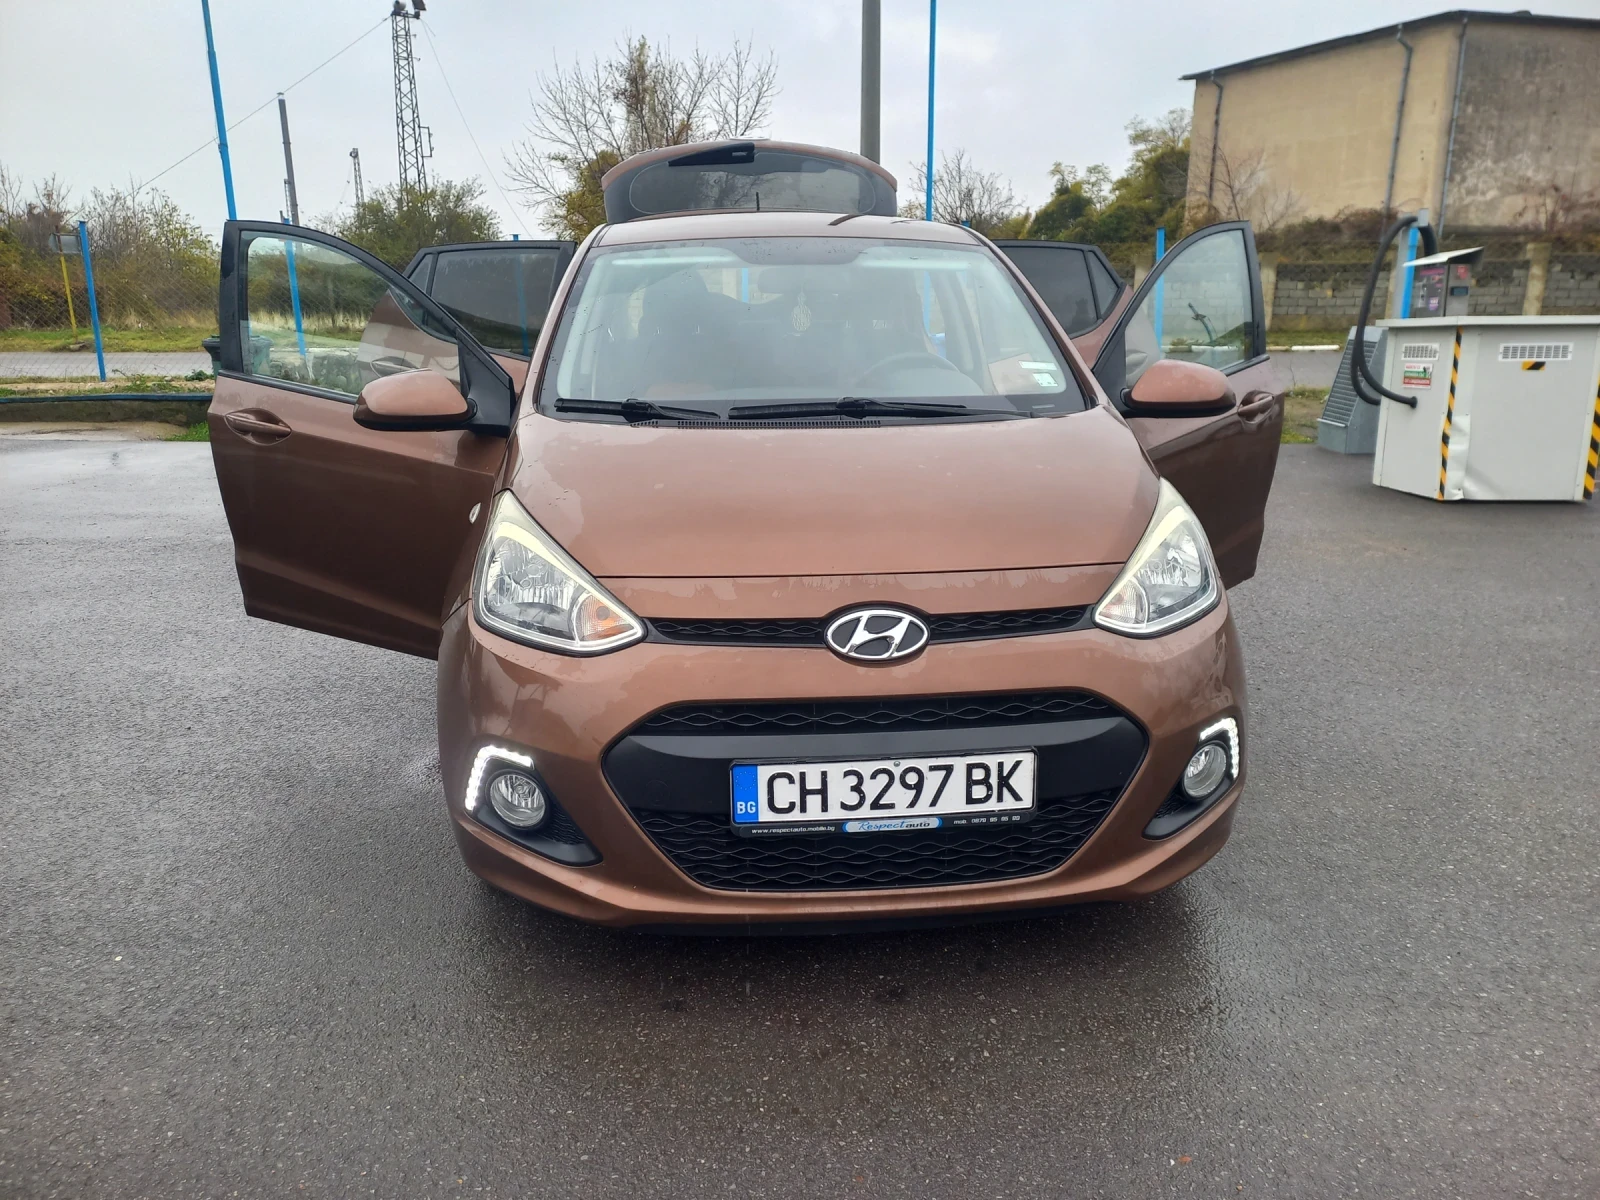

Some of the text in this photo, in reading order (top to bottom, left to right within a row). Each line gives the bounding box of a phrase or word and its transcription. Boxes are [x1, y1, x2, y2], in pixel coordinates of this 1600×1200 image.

[767, 760, 1024, 815] CH 3297 BK
[737, 801, 756, 814] BG
[751, 825, 836, 834] www.respectauto.mobile.bg
